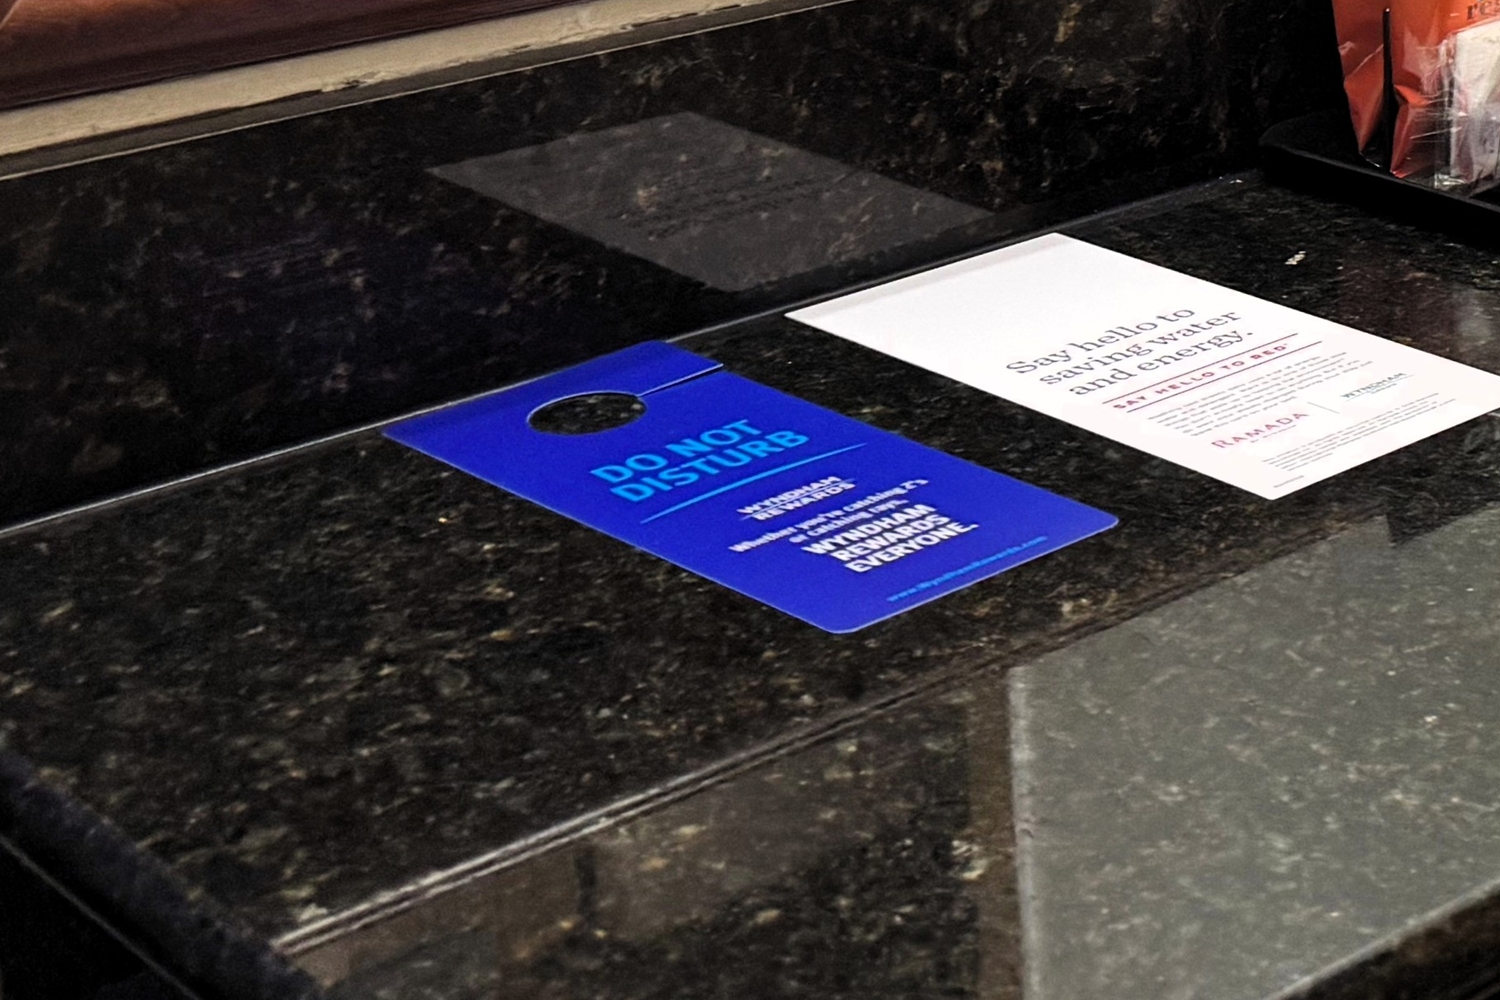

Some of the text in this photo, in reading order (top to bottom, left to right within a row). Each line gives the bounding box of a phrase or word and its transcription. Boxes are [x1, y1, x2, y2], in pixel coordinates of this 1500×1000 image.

[1006, 308, 1195, 374] Say hello to
[1039, 311, 1241, 385] saving water
[1069, 367, 1138, 395] and
[1136, 329, 1253, 371] energy.
[1113, 395, 1147, 410] SAY
[1155, 371, 1215, 395] HELLO
[1219, 360, 1245, 371] TO
[589, 418, 762, 483] DO NOT
[1211, 412, 1310, 449] RAMADA
[609, 430, 810, 502] DISTURB
[728, 526, 798, 553] Whether
[795, 509, 846, 531] you're
[843, 486, 909, 512] catching
[736, 475, 843, 514] WYNDHAM
[751, 481, 857, 521] REWARDS
[788, 534, 808, 544] or
[806, 511, 874, 537] catching
[800, 503, 937, 555] WYNDHAM
[829, 513, 952, 562] REWARDS
[844, 521, 979, 573] EVERYONE.
